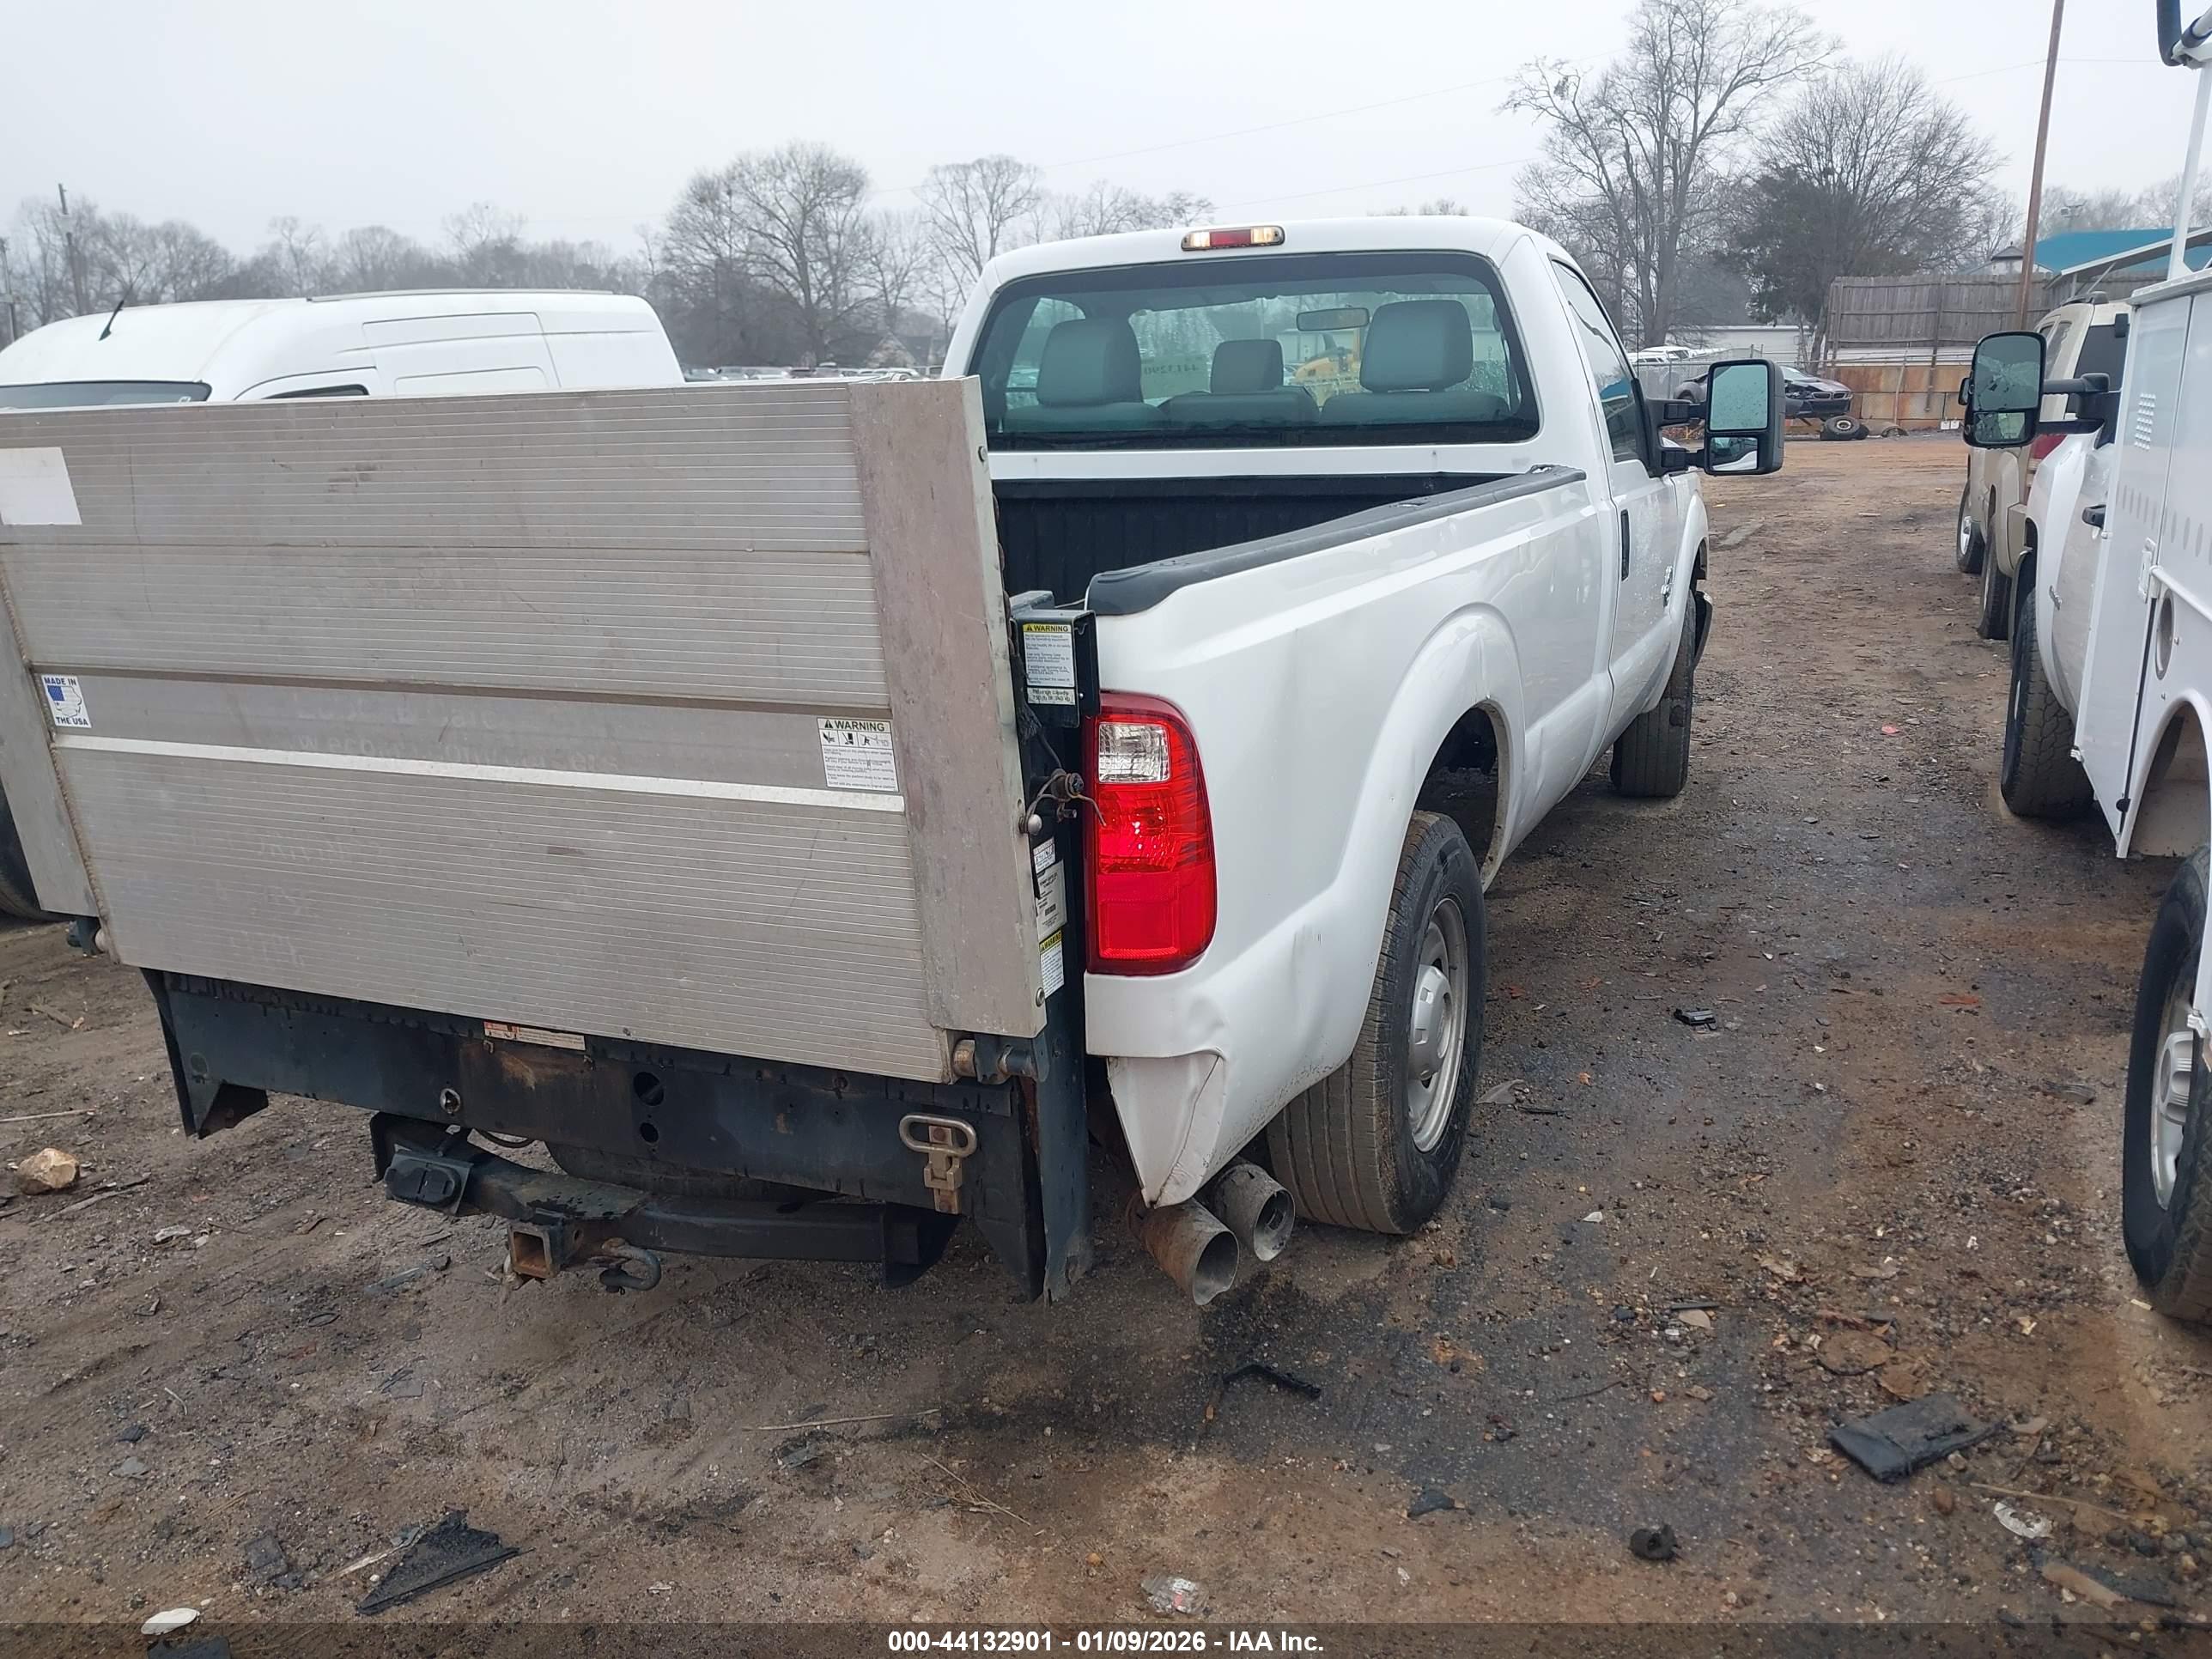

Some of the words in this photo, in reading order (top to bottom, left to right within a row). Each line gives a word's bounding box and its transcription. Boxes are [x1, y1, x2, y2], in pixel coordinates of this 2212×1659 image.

[55, 716, 71, 725] THE
[72, 717, 88, 726] USA
[835, 720, 885, 732] WARNING
